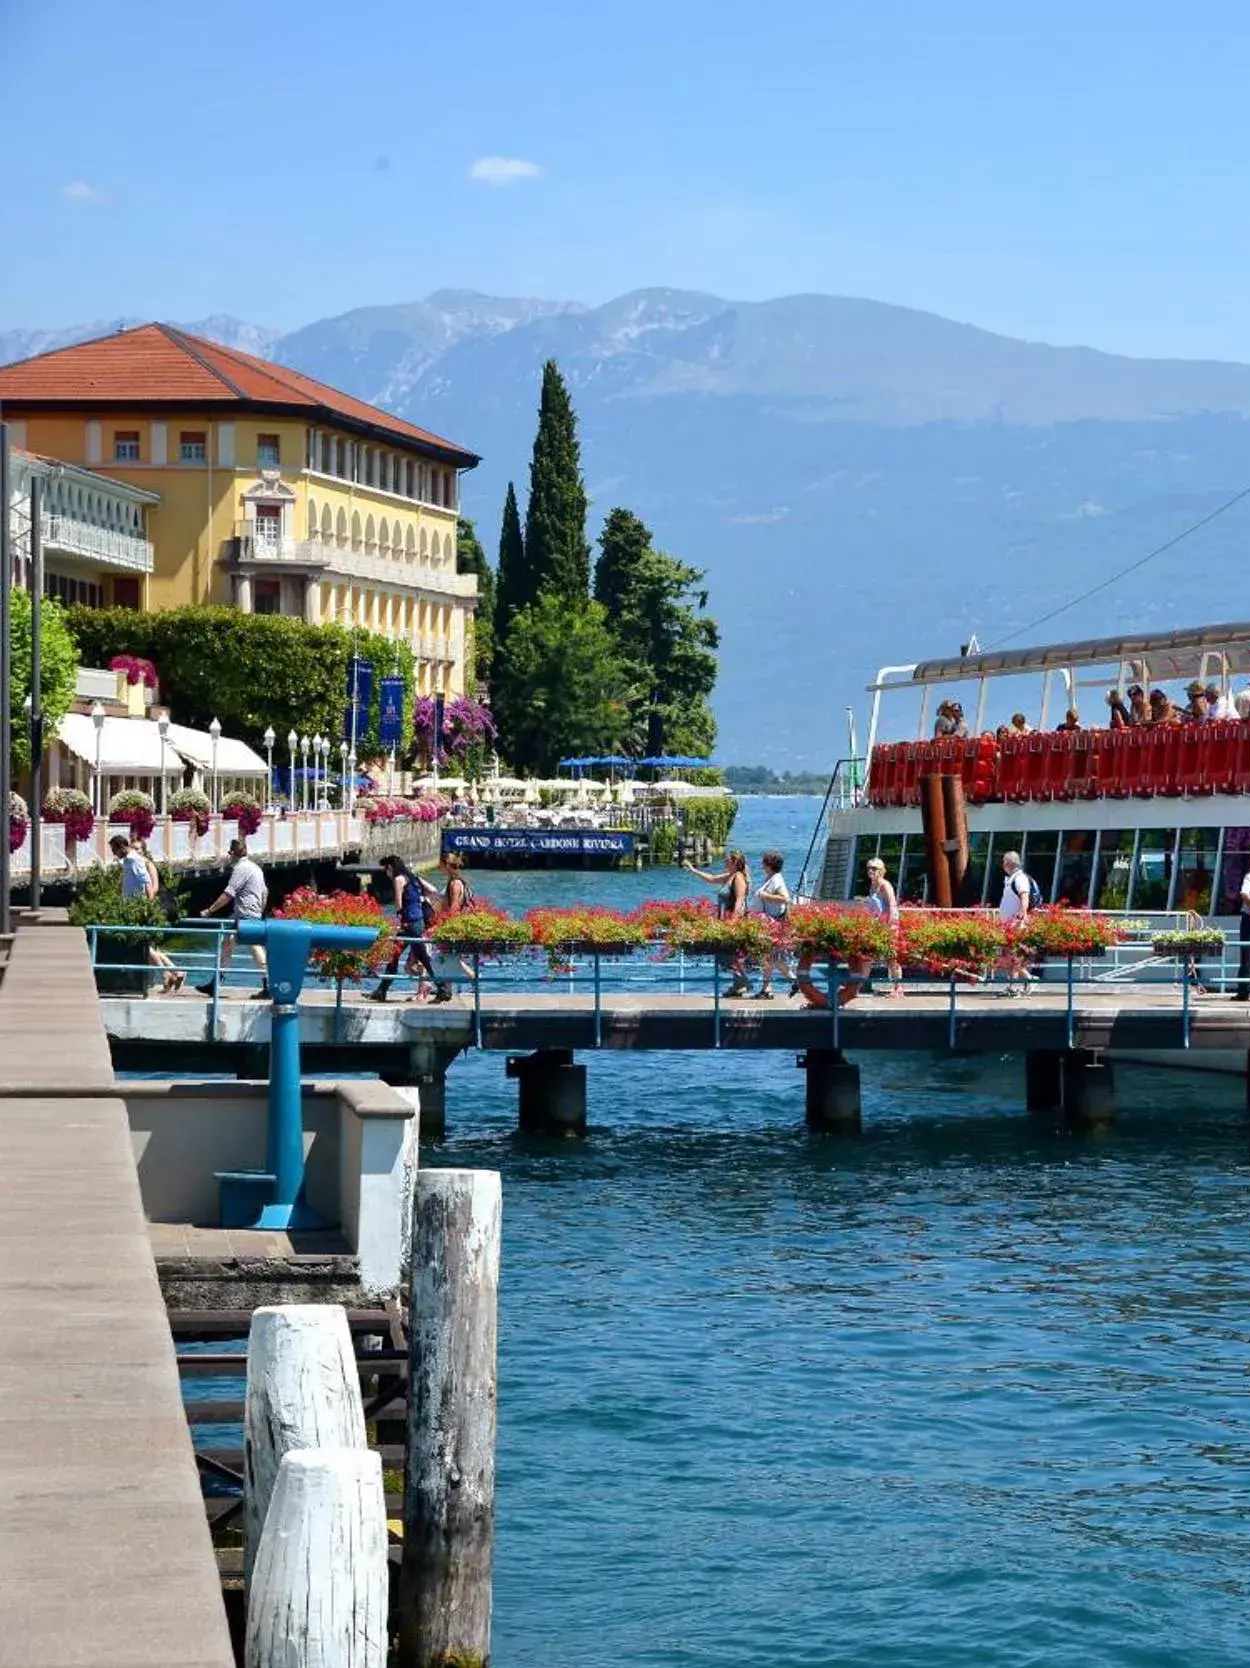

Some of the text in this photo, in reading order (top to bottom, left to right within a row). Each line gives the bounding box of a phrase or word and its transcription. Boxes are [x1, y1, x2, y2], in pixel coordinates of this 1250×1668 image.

[454, 835, 491, 848] GRAND
[494, 837, 527, 848] HOTEL
[582, 837, 624, 850] RIVIERA
